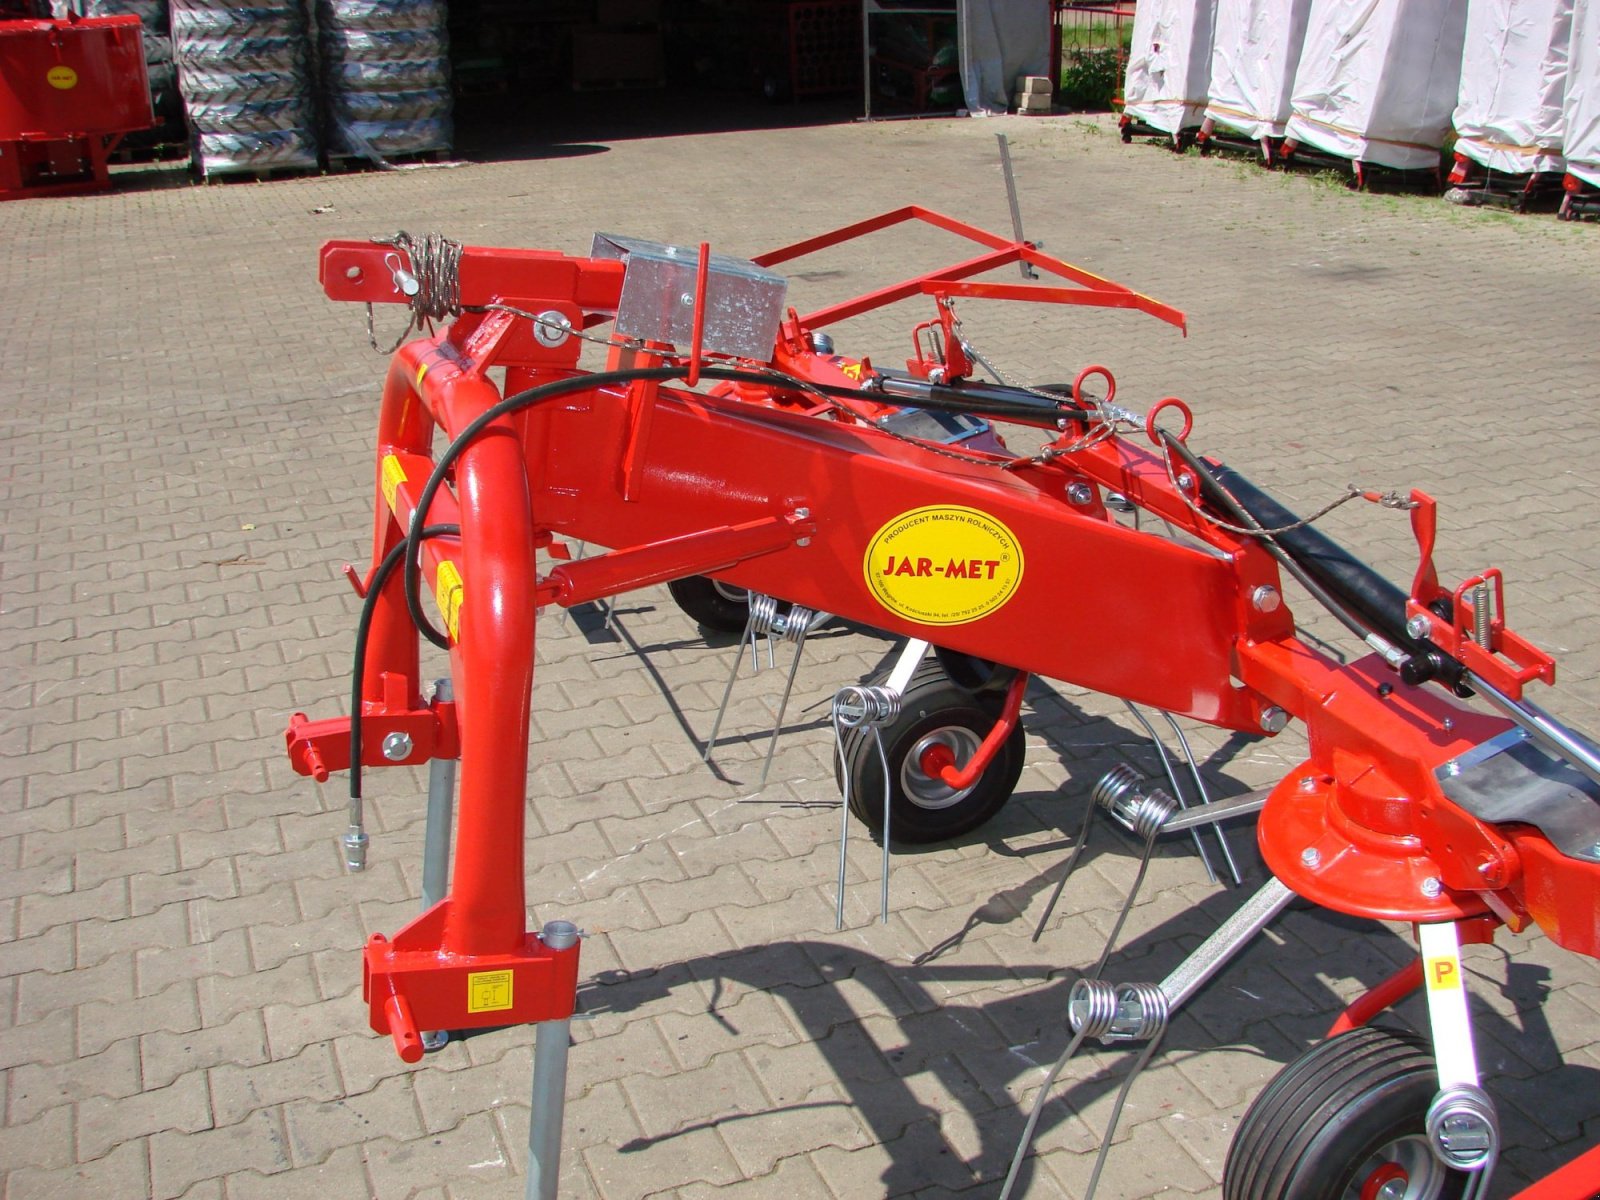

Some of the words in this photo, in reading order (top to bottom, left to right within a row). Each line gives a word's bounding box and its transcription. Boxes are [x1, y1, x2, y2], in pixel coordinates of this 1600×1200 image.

[884, 515, 929, 544] PRODUCENT
[932, 514, 966, 522] MASZYN
[967, 517, 1010, 549] ROLNICZYCH
[883, 556, 1000, 580] JAR-MET
[1435, 961, 1454, 984] P
